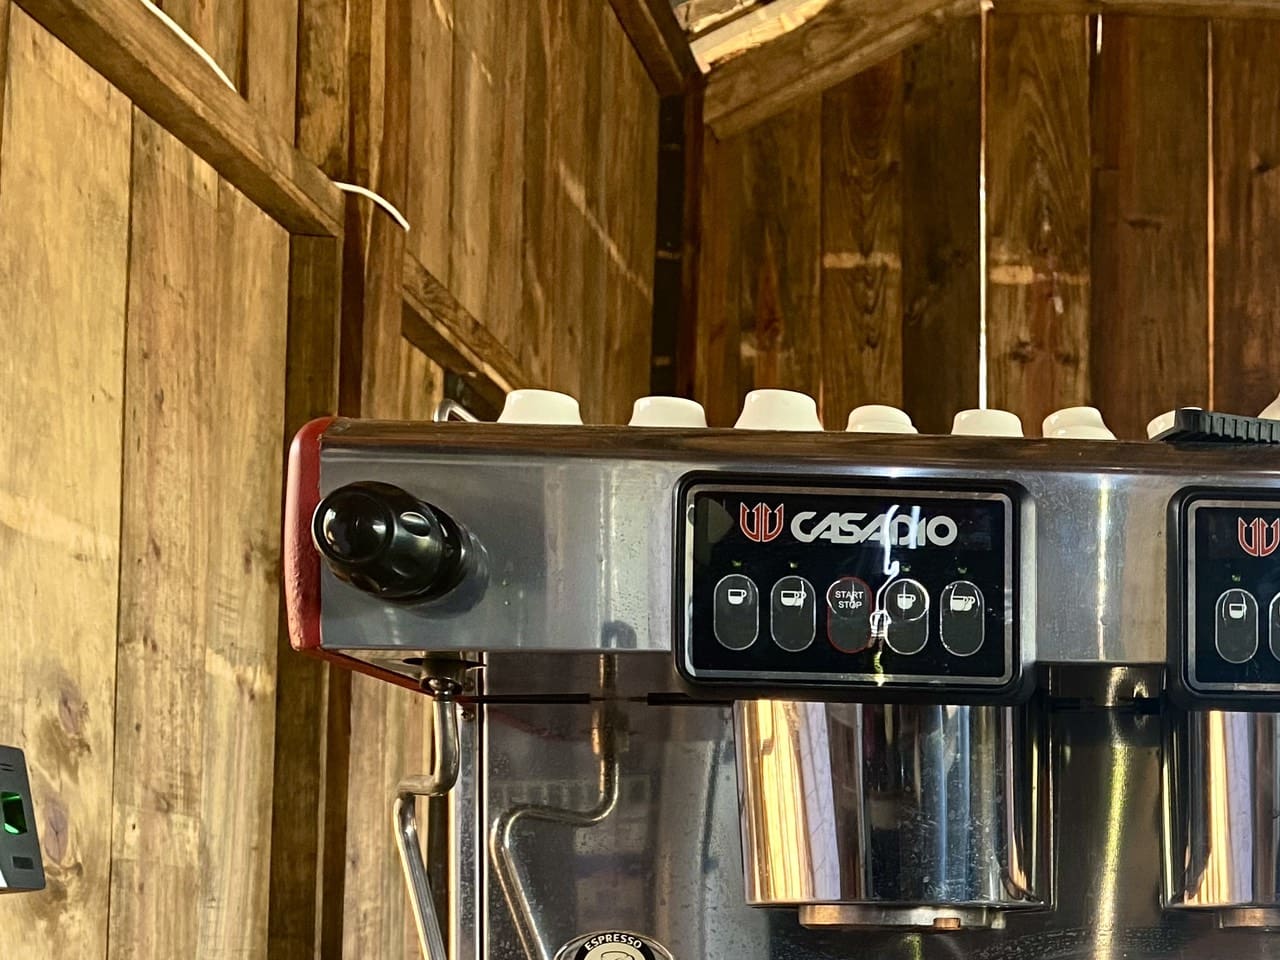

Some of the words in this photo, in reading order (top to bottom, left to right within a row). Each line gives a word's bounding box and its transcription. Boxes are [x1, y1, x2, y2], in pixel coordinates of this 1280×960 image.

[790, 511, 958, 546] CASADIO
[835, 590, 864, 600] START
[838, 600, 862, 609] STOP
[584, 934, 642, 951] ESPRESSO
